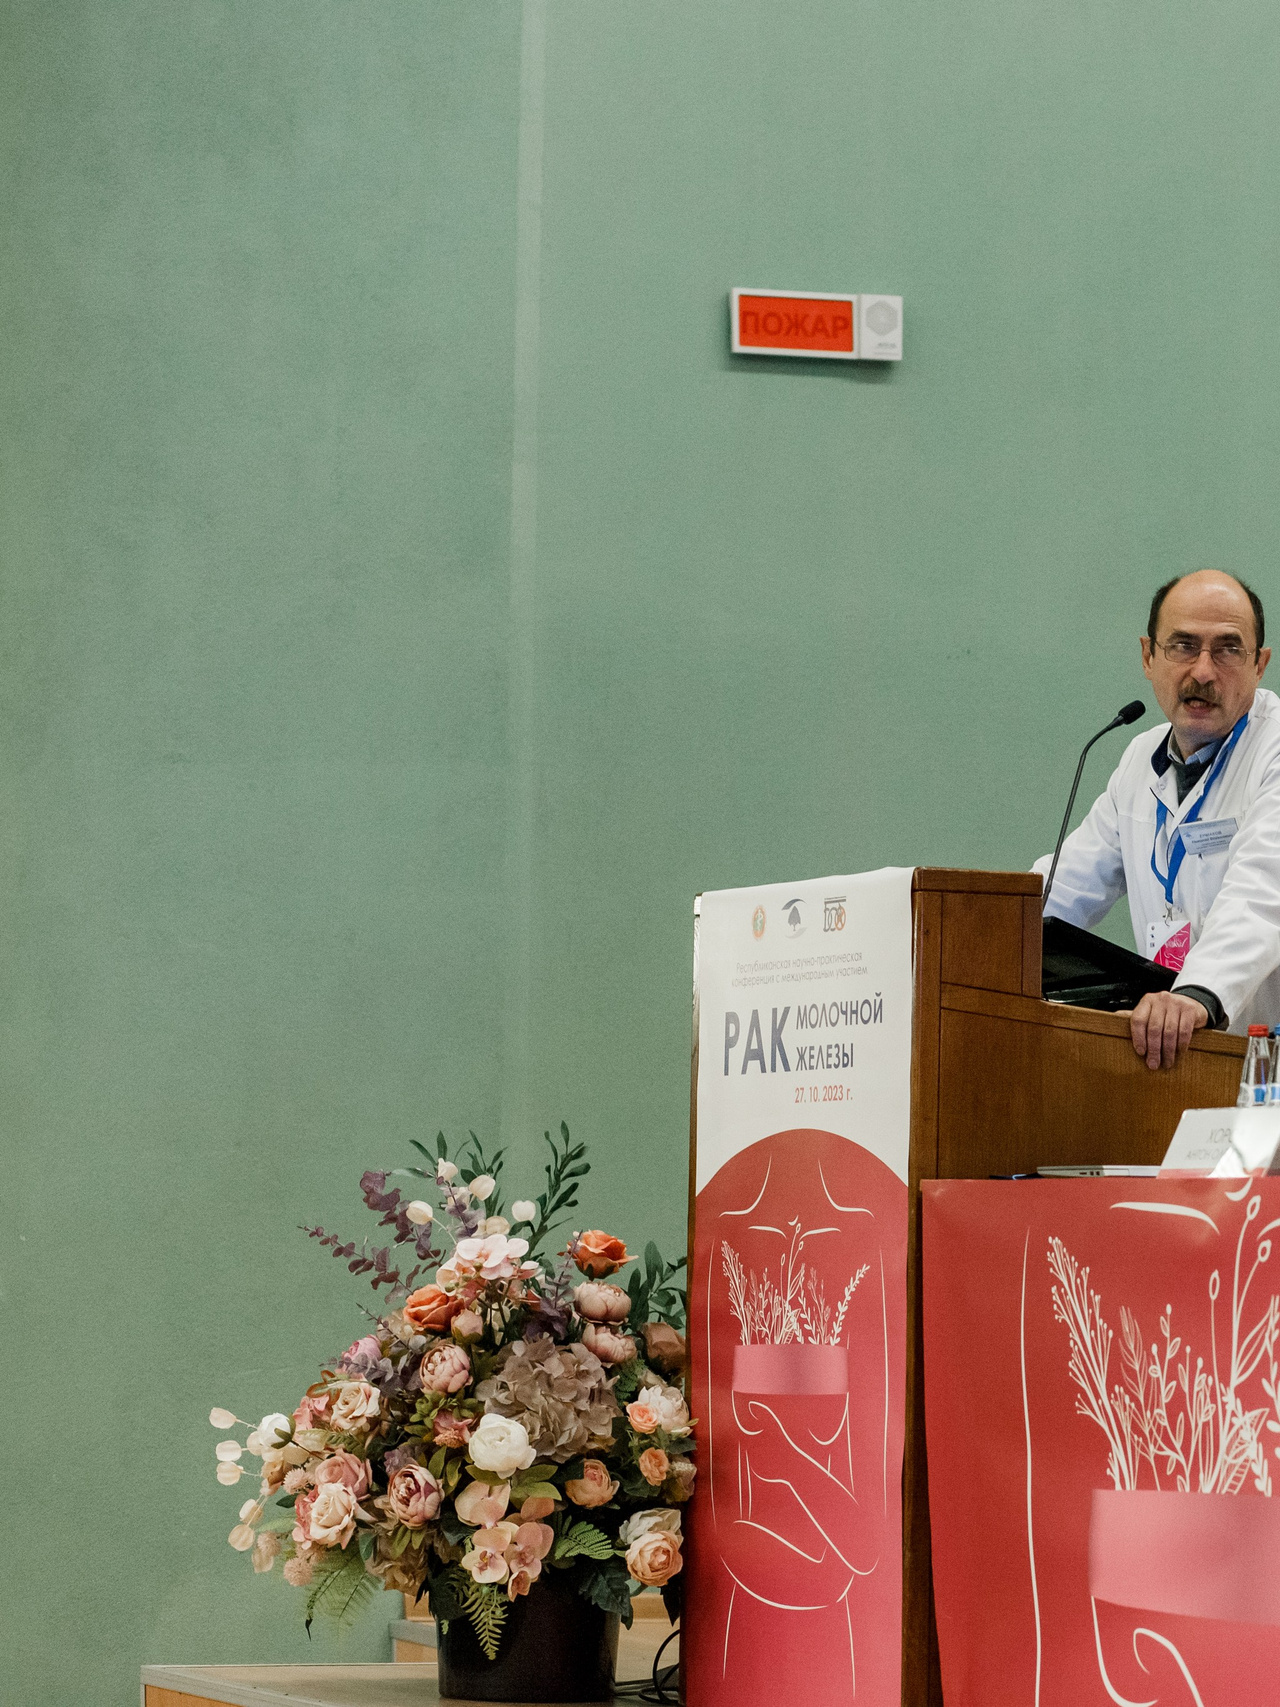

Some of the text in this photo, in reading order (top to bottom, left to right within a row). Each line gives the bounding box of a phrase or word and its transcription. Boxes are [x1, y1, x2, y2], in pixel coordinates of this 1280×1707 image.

[742, 311, 850, 338] ПОЖАР
[731, 975, 775, 988] конференция
[781, 969, 834, 983] международным
[835, 966, 868, 979] участием
[736, 952, 862, 974] Республиканская научно-практическая
[796, 992, 883, 1030] МОЛОЧНОЙ
[723, 1006, 791, 1076] РАК
[796, 1043, 854, 1072] ЖЕЛЕЗЫ
